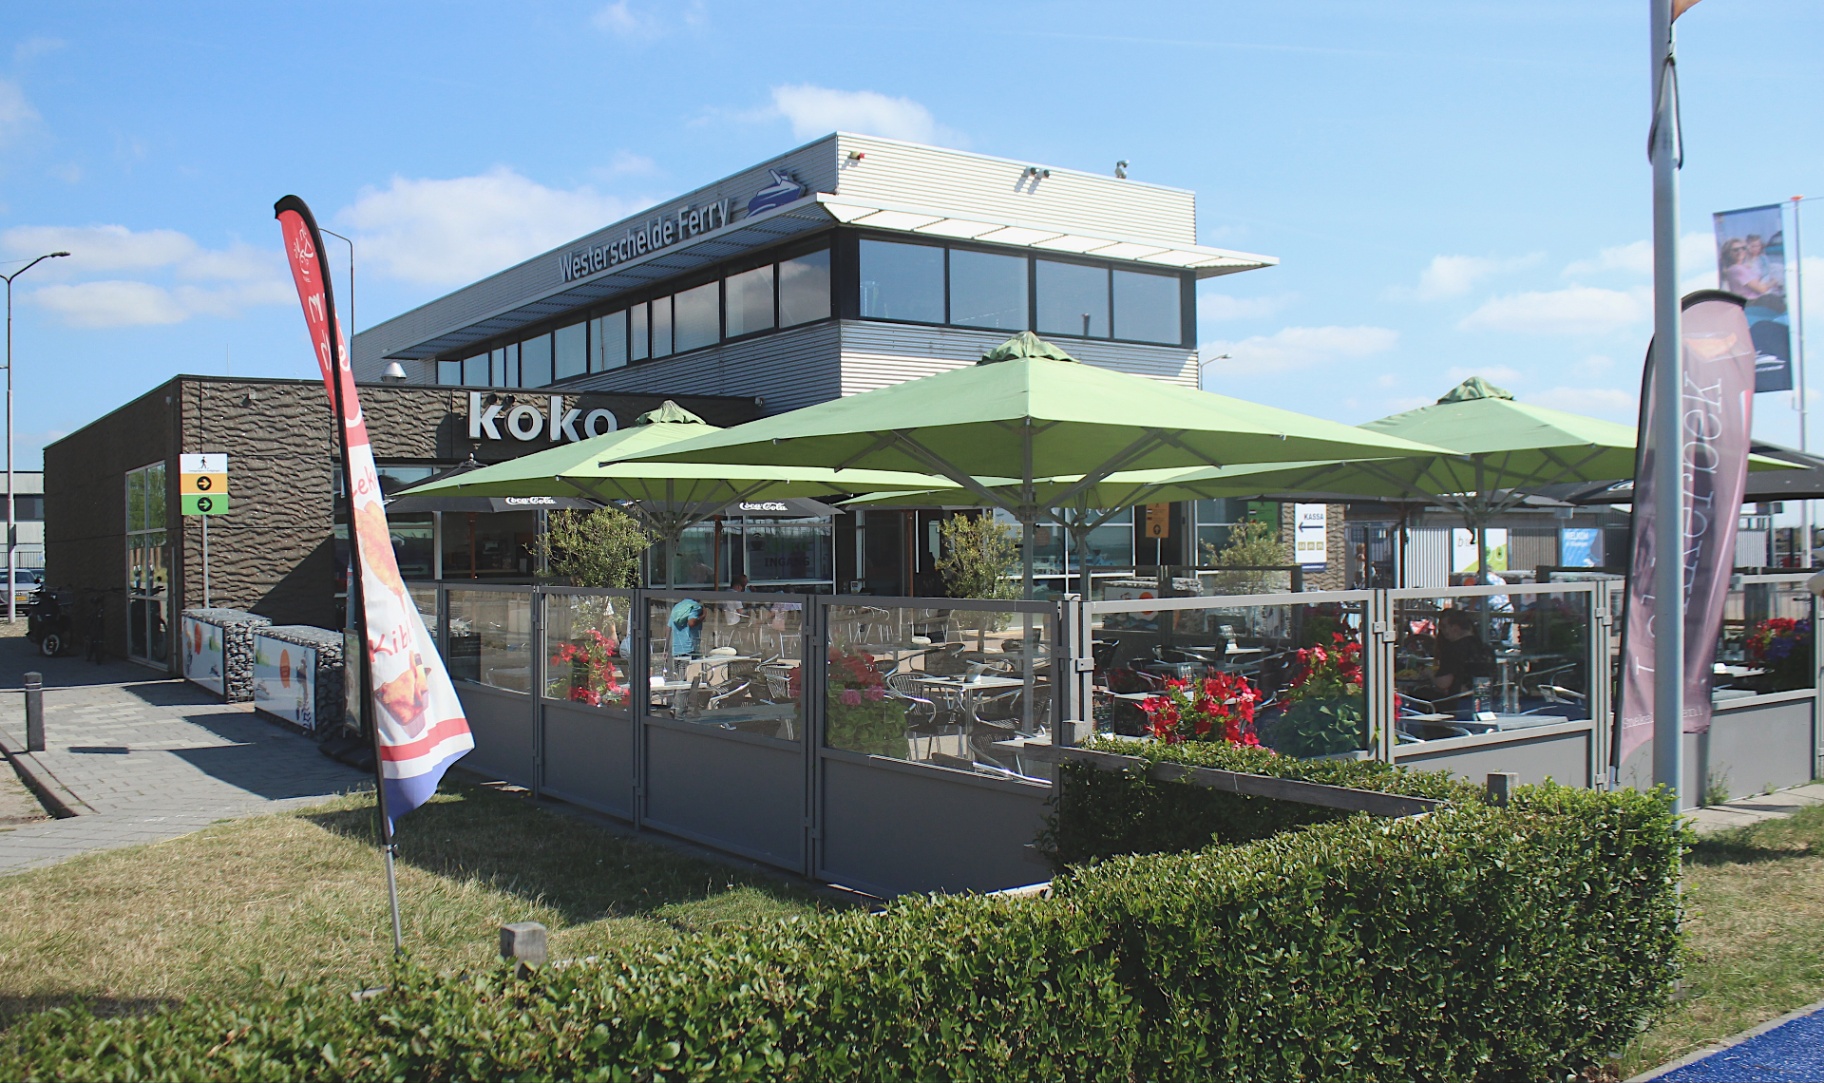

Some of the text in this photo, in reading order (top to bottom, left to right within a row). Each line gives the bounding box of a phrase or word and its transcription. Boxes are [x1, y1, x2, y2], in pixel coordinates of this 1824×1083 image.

[558, 198, 730, 283] Westerschelde Ferry
[468, 391, 619, 442] koko
[505, 496, 557, 505] Coca-Cola
[739, 501, 789, 511] Coca-Cola
